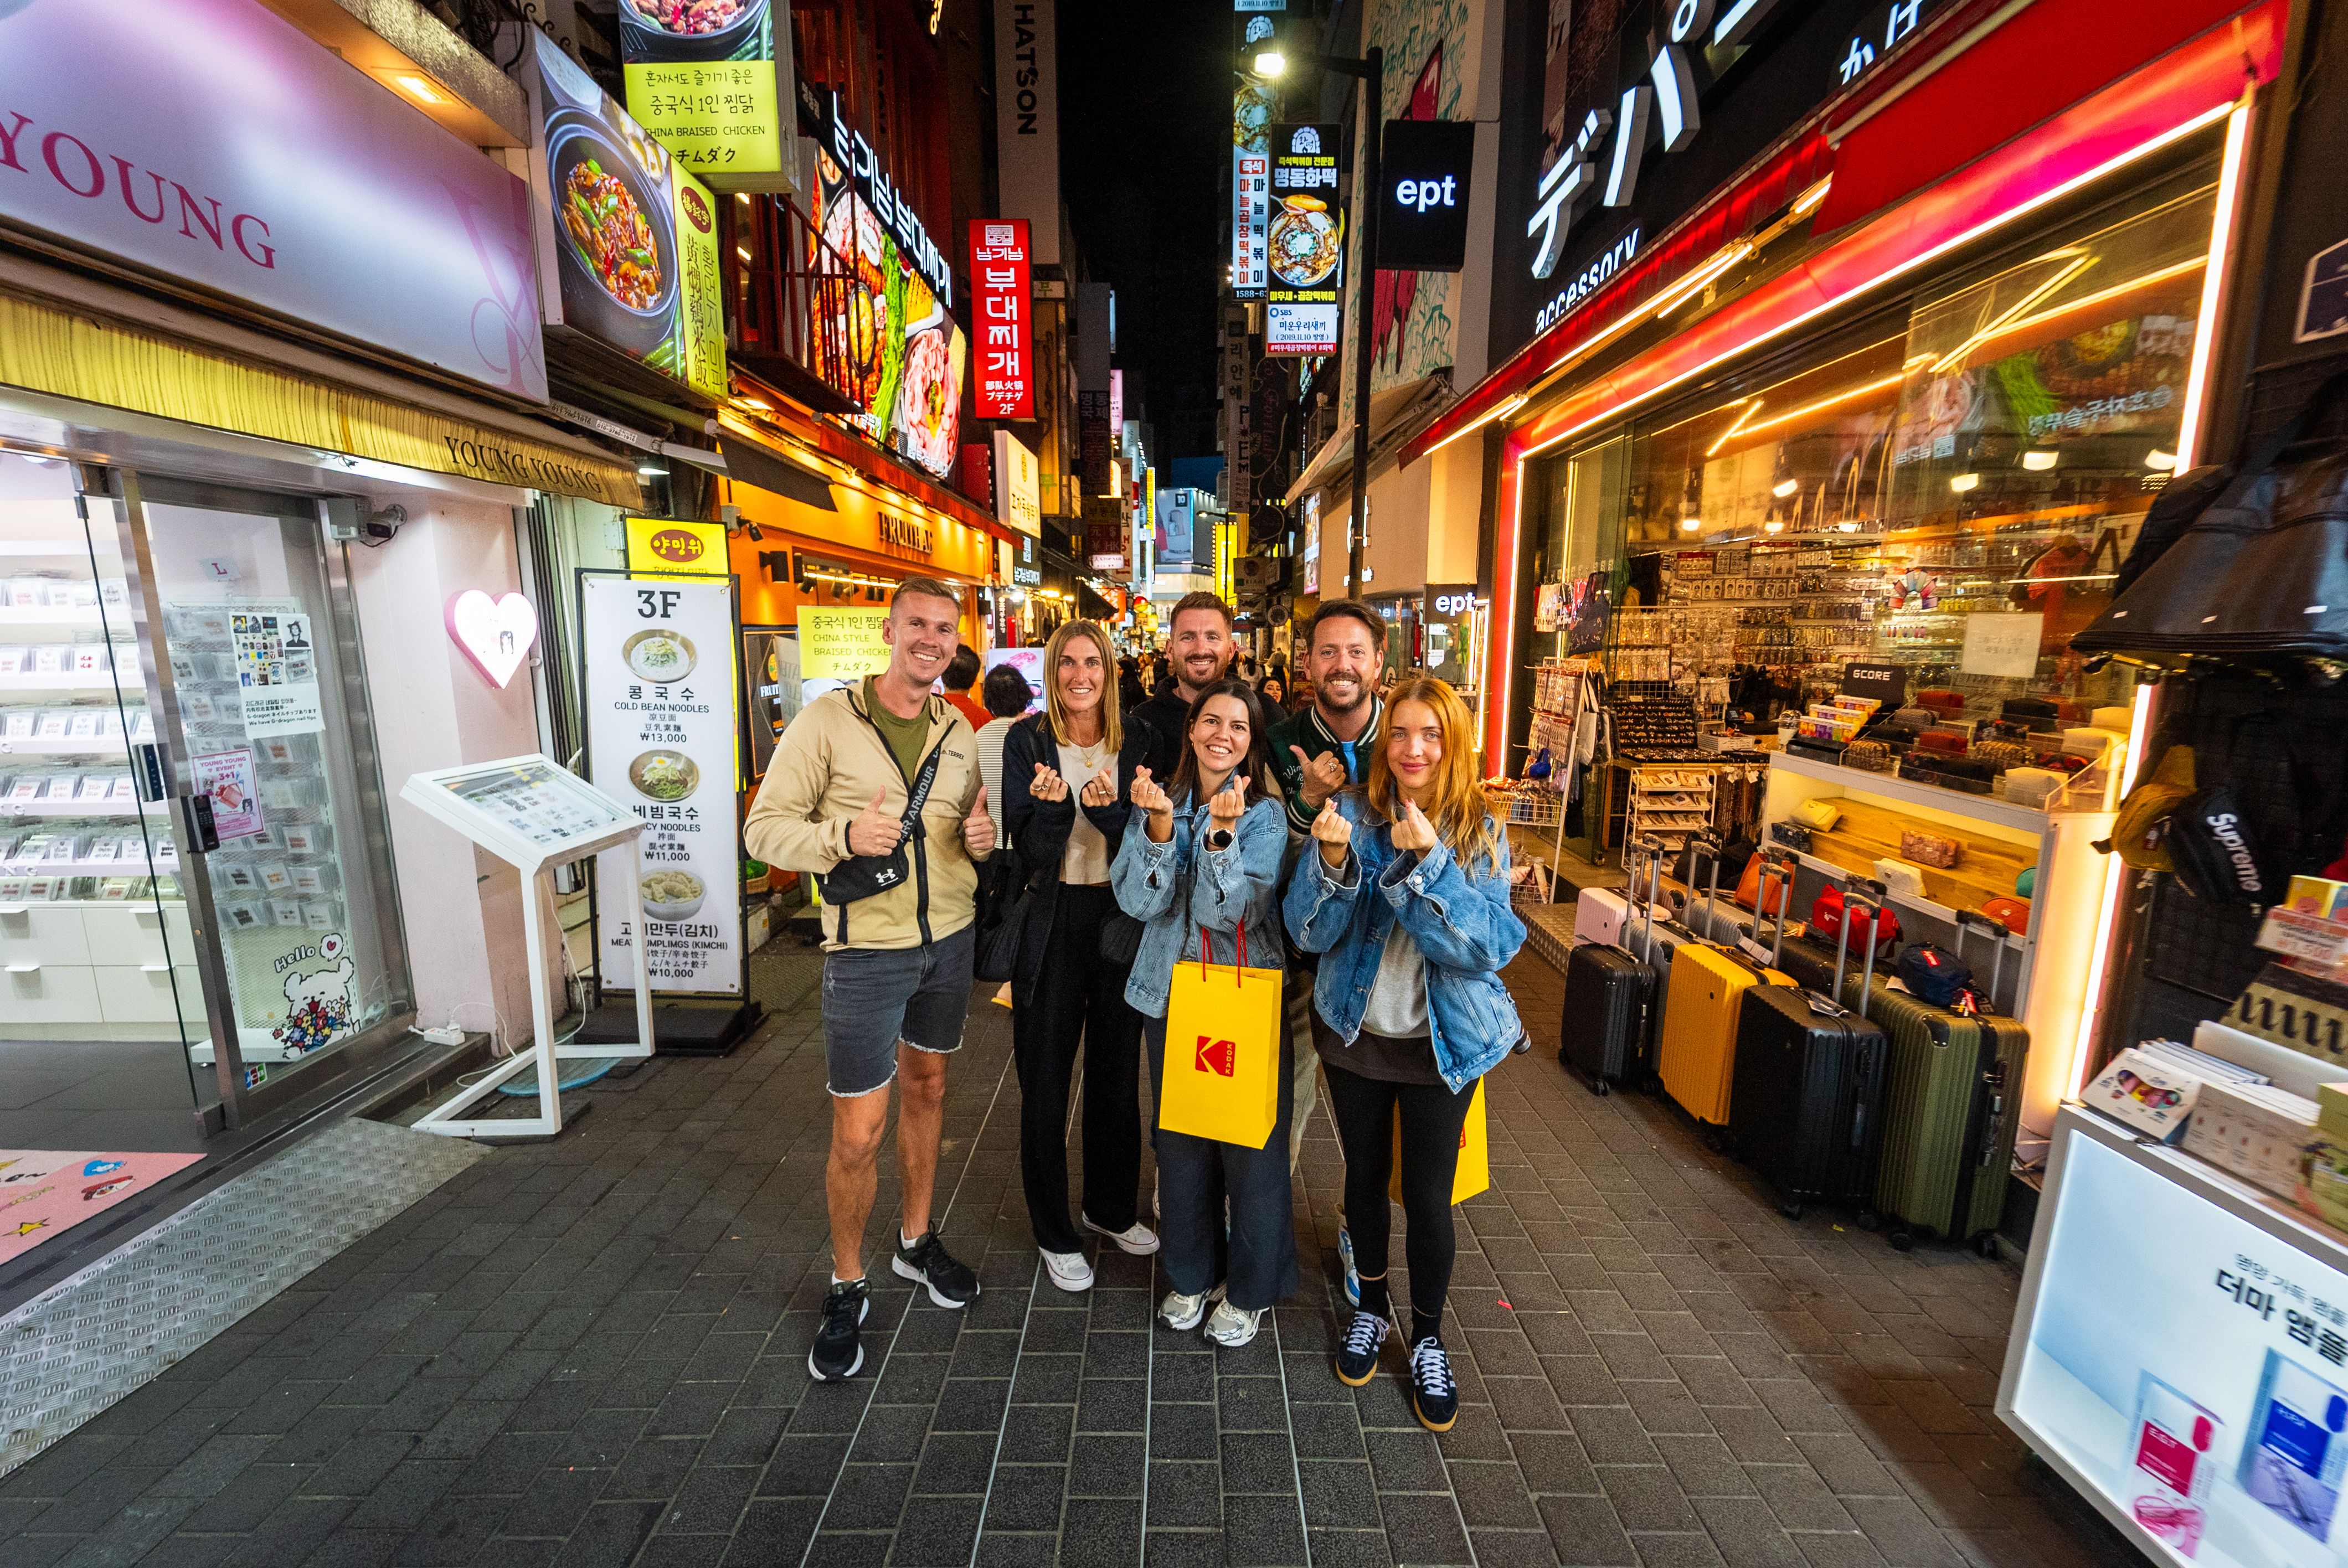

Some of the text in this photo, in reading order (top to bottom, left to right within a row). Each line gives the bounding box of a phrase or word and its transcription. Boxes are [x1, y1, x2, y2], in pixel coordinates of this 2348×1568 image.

[645, 69, 753, 87] 혼자서도 즐기기 좋은
[650, 95, 754, 116] 중국식 1인 찜닭
[677, 126, 718, 137] BRAISED
[723, 126, 765, 136] CHICKEN
[676, 148, 736, 164] チムダク
[1242, 161, 1262, 173] 즉석
[1274, 167, 1337, 188] 명동화떡
[0, 111, 276, 269] YOUNG
[1397, 176, 1456, 213] ept
[1253, 179, 1265, 282] 마늘떡볶이
[976, 247, 1023, 261] 남기남
[1536, 228, 1639, 335] accessory
[985, 267, 1019, 376] 부대찌개
[1280, 321, 1326, 331] 미운우리새끼
[985, 380, 1023, 390] 部队火锅
[986, 391, 1023, 401] ブデチゲ
[999, 404, 1015, 414] 2F
[444, 435, 602, 493] YOUNG YOUNG
[653, 537, 702, 555] 양밍위
[637, 590, 681, 618] 3F
[1435, 592, 1475, 616] ept
[812, 616, 844, 630] 중국식
[848, 617, 862, 629] 1인
[813, 634, 870, 642] CHINA STYLE
[814, 648, 852, 656] BRAISED
[832, 662, 872, 671] チムダク
[1852, 669, 1891, 680] GCORE
[615, 702, 709, 713] COLD BEAN NOODLES
[640, 733, 687, 744] ₩13,000
[948, 750, 965, 760] TERREX
[200, 759, 223, 768] YOUNG
[909, 766, 935, 819] ARMOUR
[661, 823, 701, 832] NOODLES
[645, 851, 691, 862] ₩11,000
[692, 940, 728, 951] (KIMCHI)
[275, 945, 316, 973] Hello
[648, 968, 693, 979] ₩10,000
[2217, 1268, 2277, 1321] 더마
